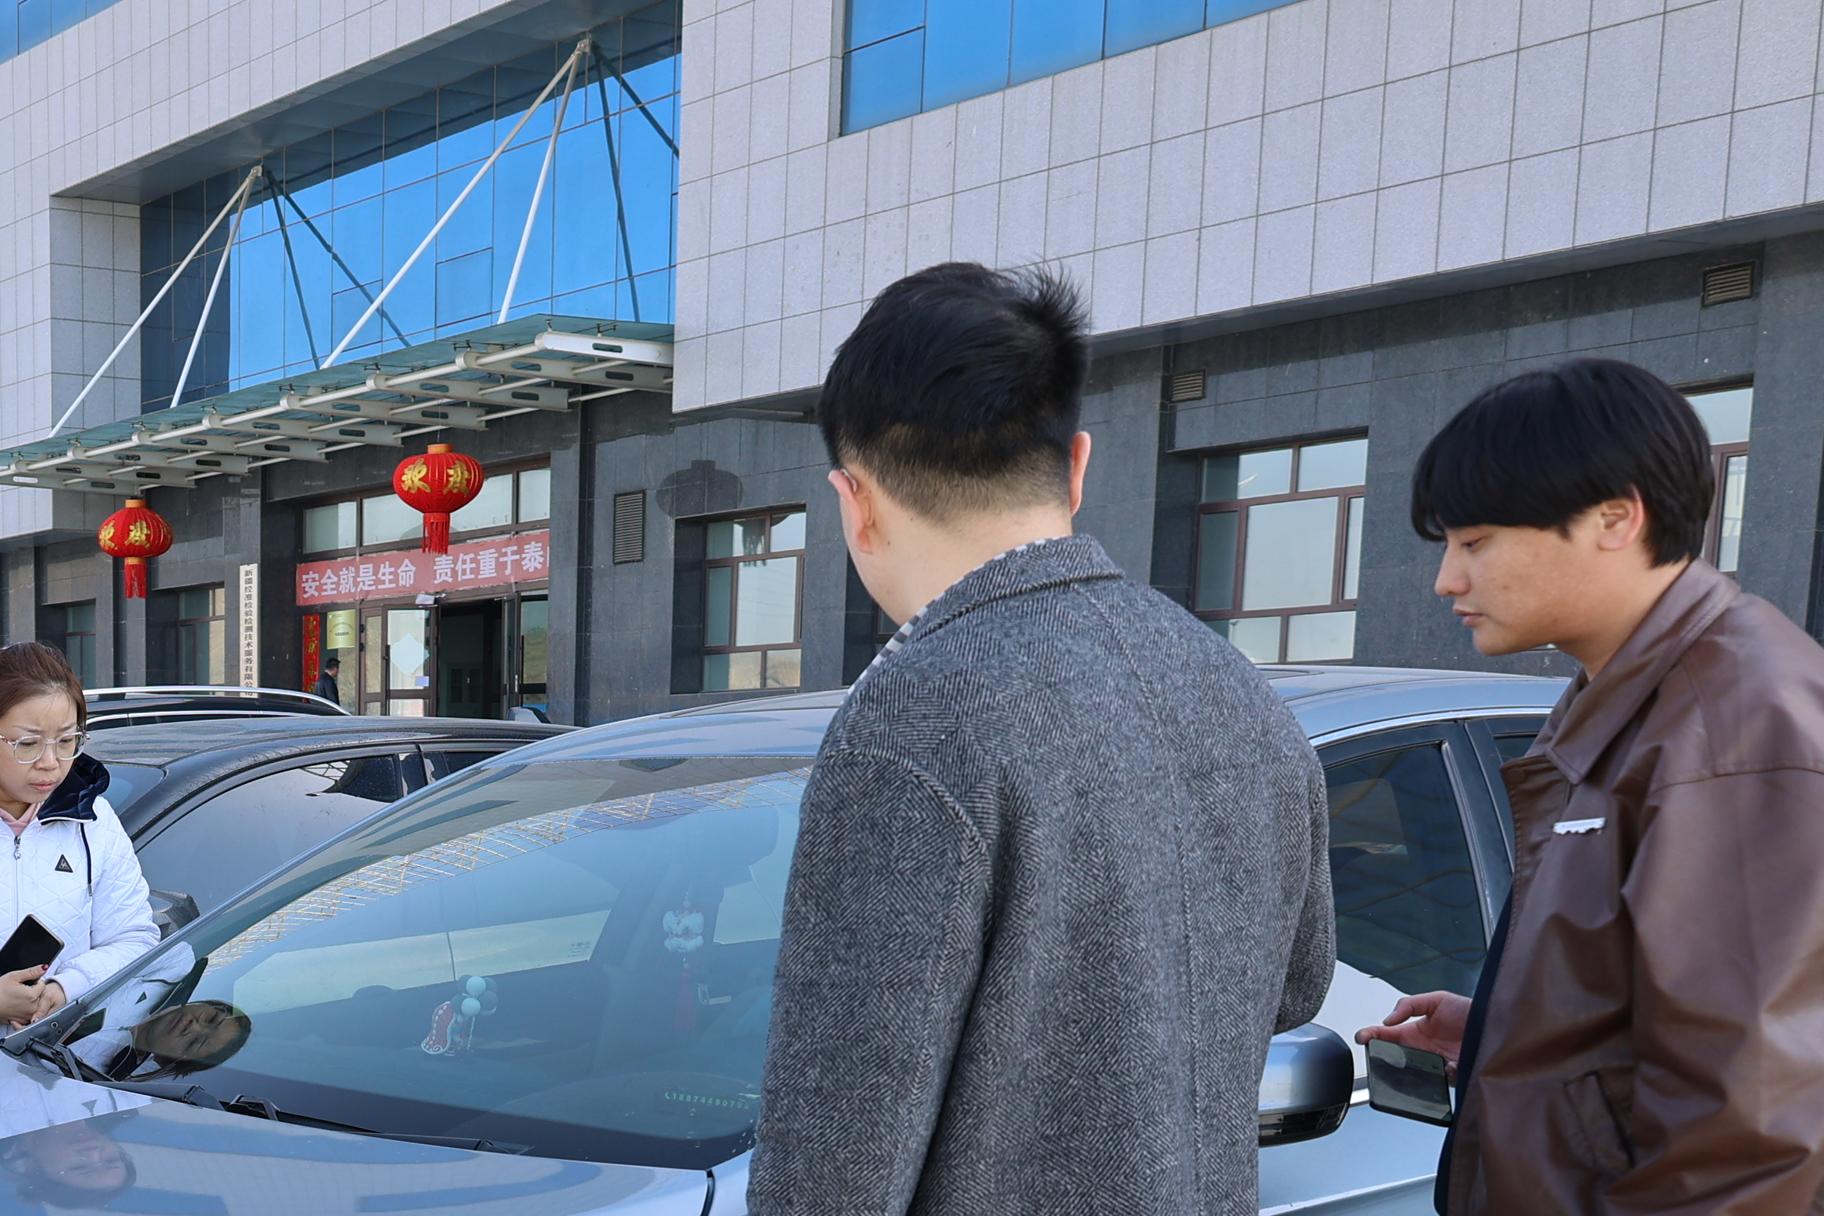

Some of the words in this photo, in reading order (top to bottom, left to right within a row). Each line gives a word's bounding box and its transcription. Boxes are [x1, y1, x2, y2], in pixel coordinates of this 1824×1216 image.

[301, 558, 417, 598] 安全就是生命
[433, 540, 549, 584] 责任重于泰
